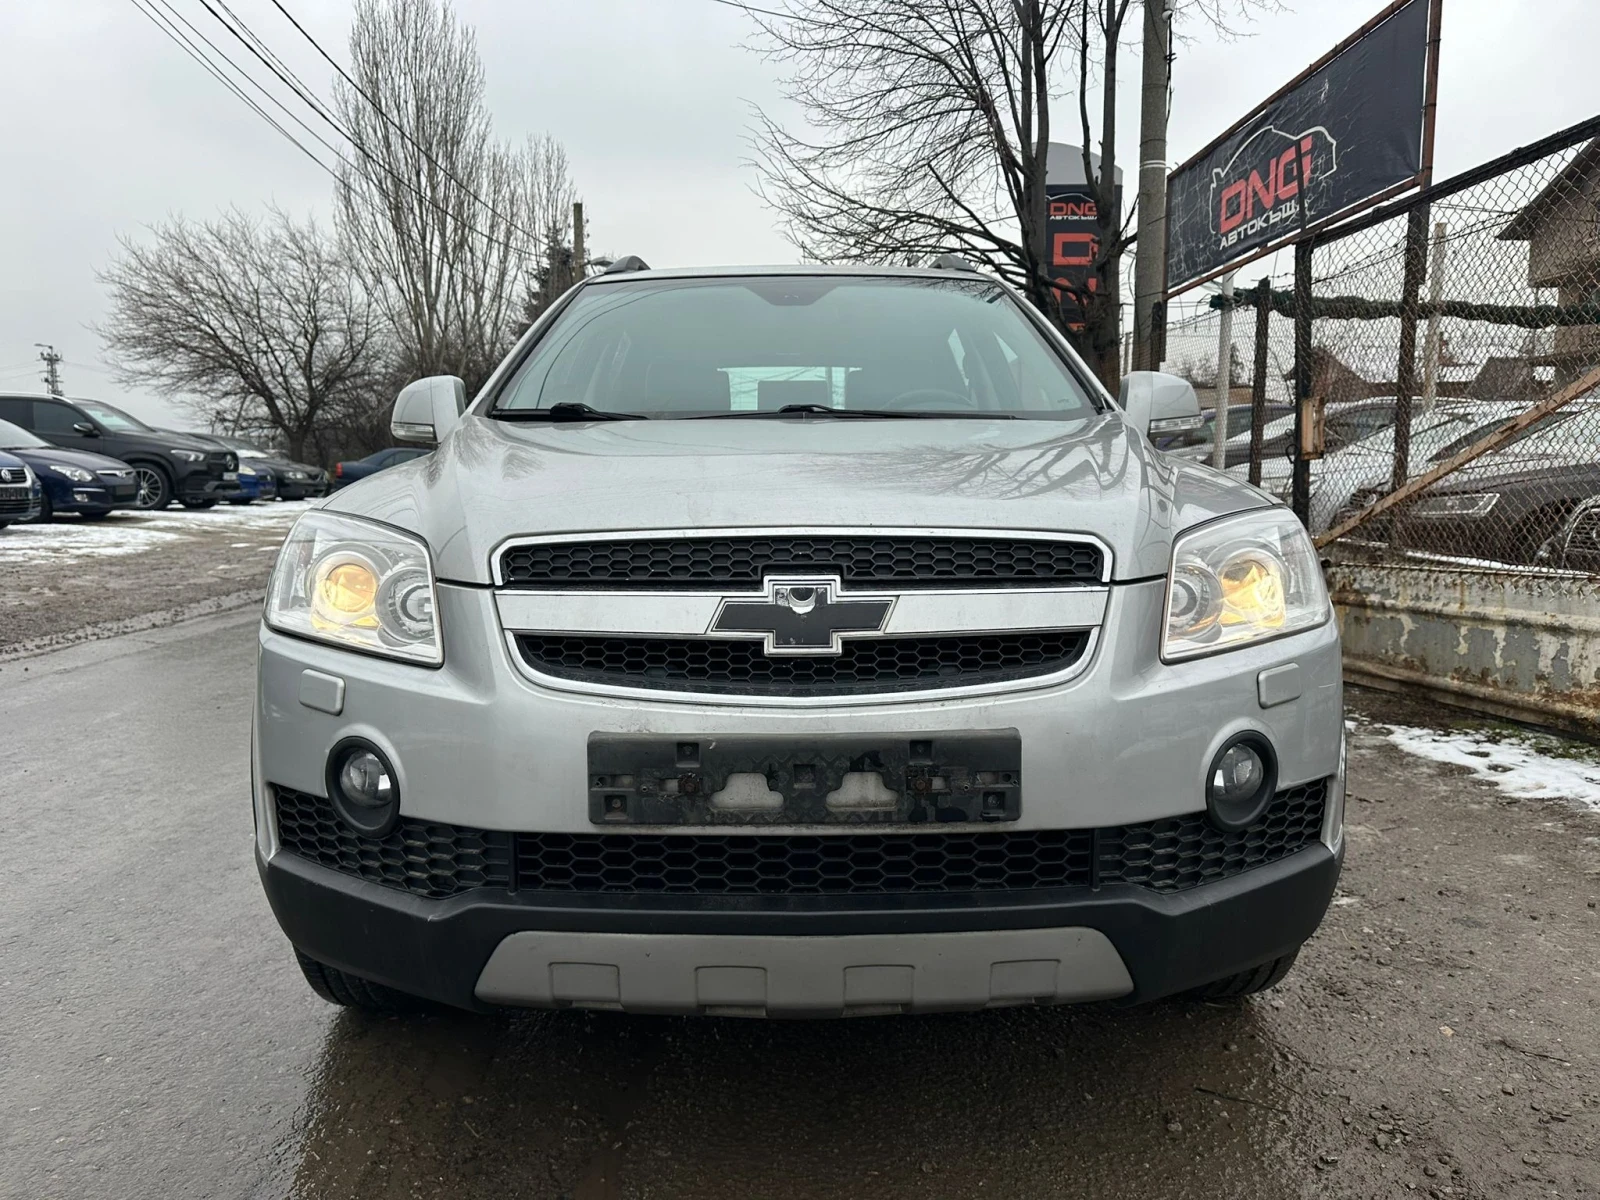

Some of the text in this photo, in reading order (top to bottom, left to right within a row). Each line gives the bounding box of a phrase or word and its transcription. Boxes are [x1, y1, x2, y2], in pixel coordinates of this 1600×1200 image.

[1050, 202, 1097, 215] DNG
[1220, 135, 1312, 233] DNG
[1219, 199, 1303, 250] АВТОКЪЩ
